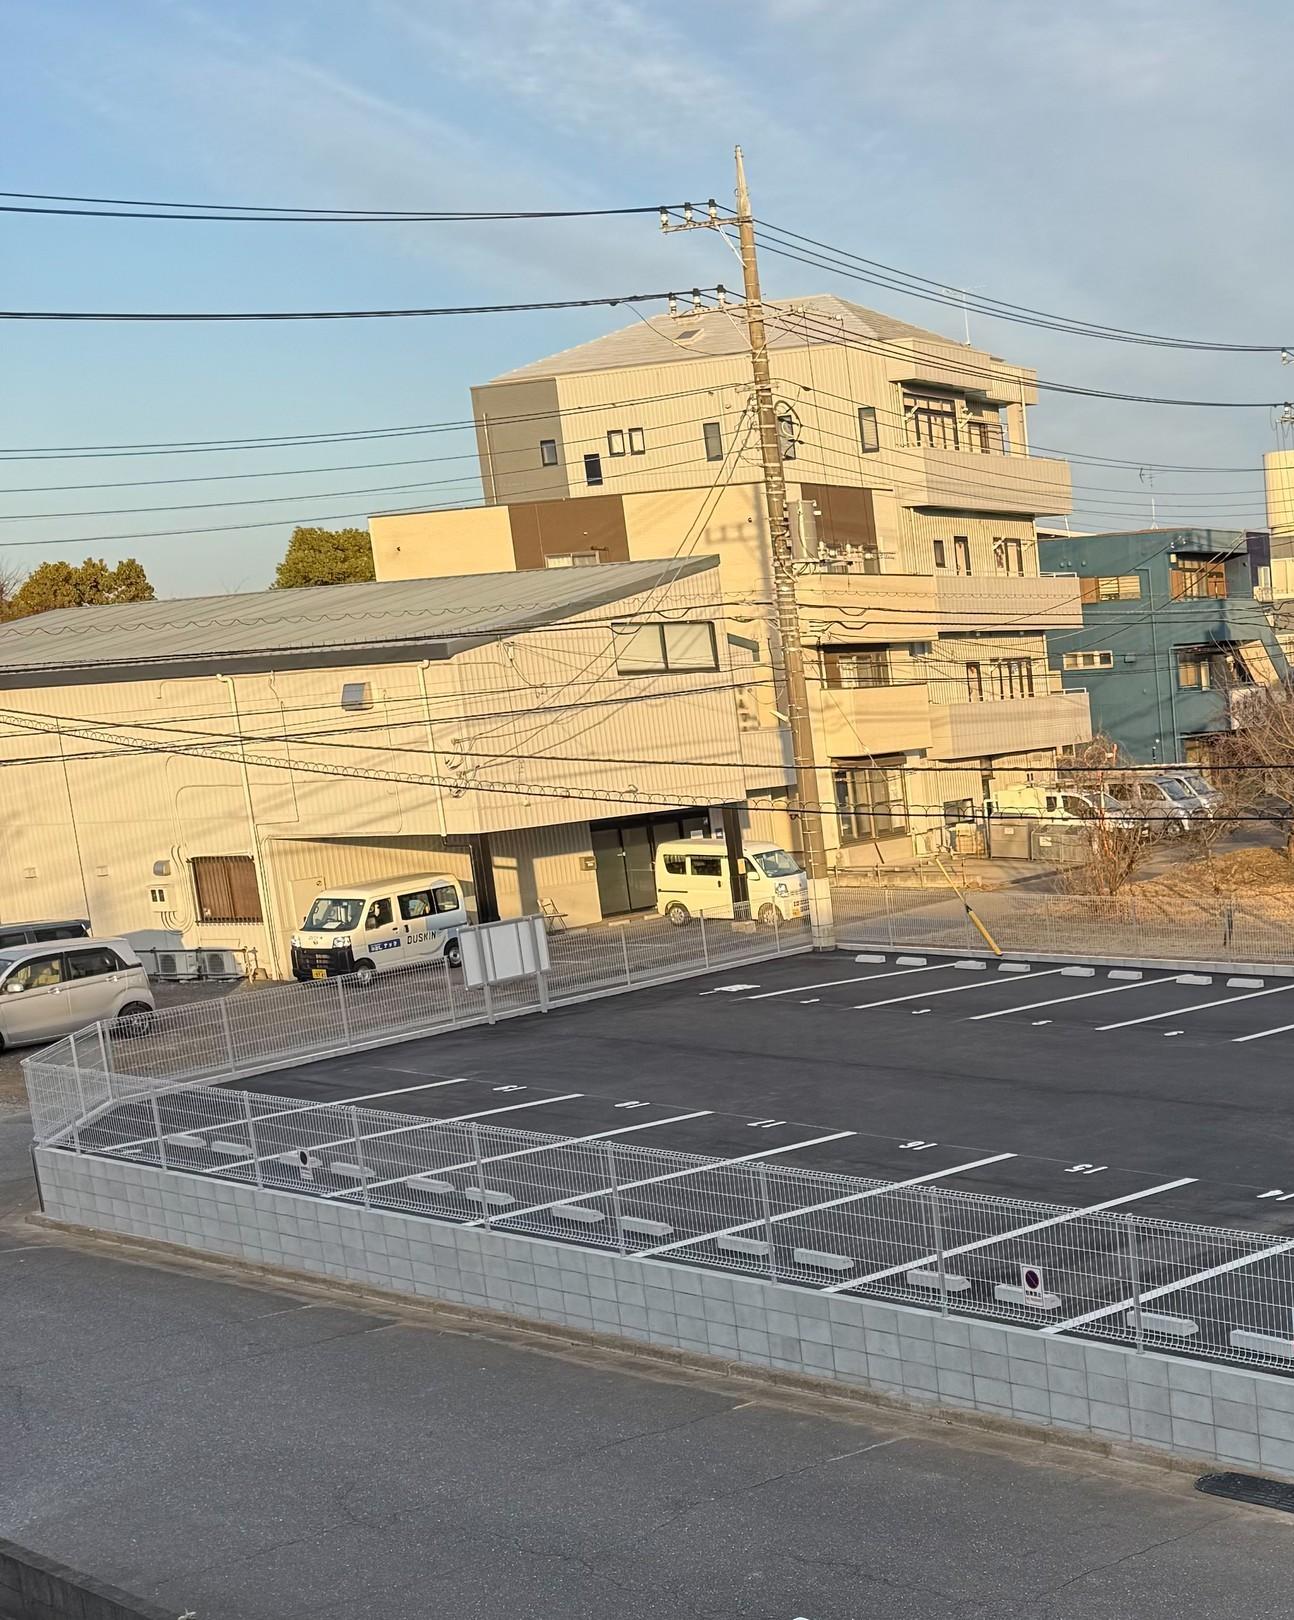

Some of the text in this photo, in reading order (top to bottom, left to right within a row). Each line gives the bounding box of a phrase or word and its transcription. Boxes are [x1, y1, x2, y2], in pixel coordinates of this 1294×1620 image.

[407, 931, 437, 945] DUSKIN
[898, 1140, 938, 1151] 16
[1063, 1163, 1109, 1175] 15
